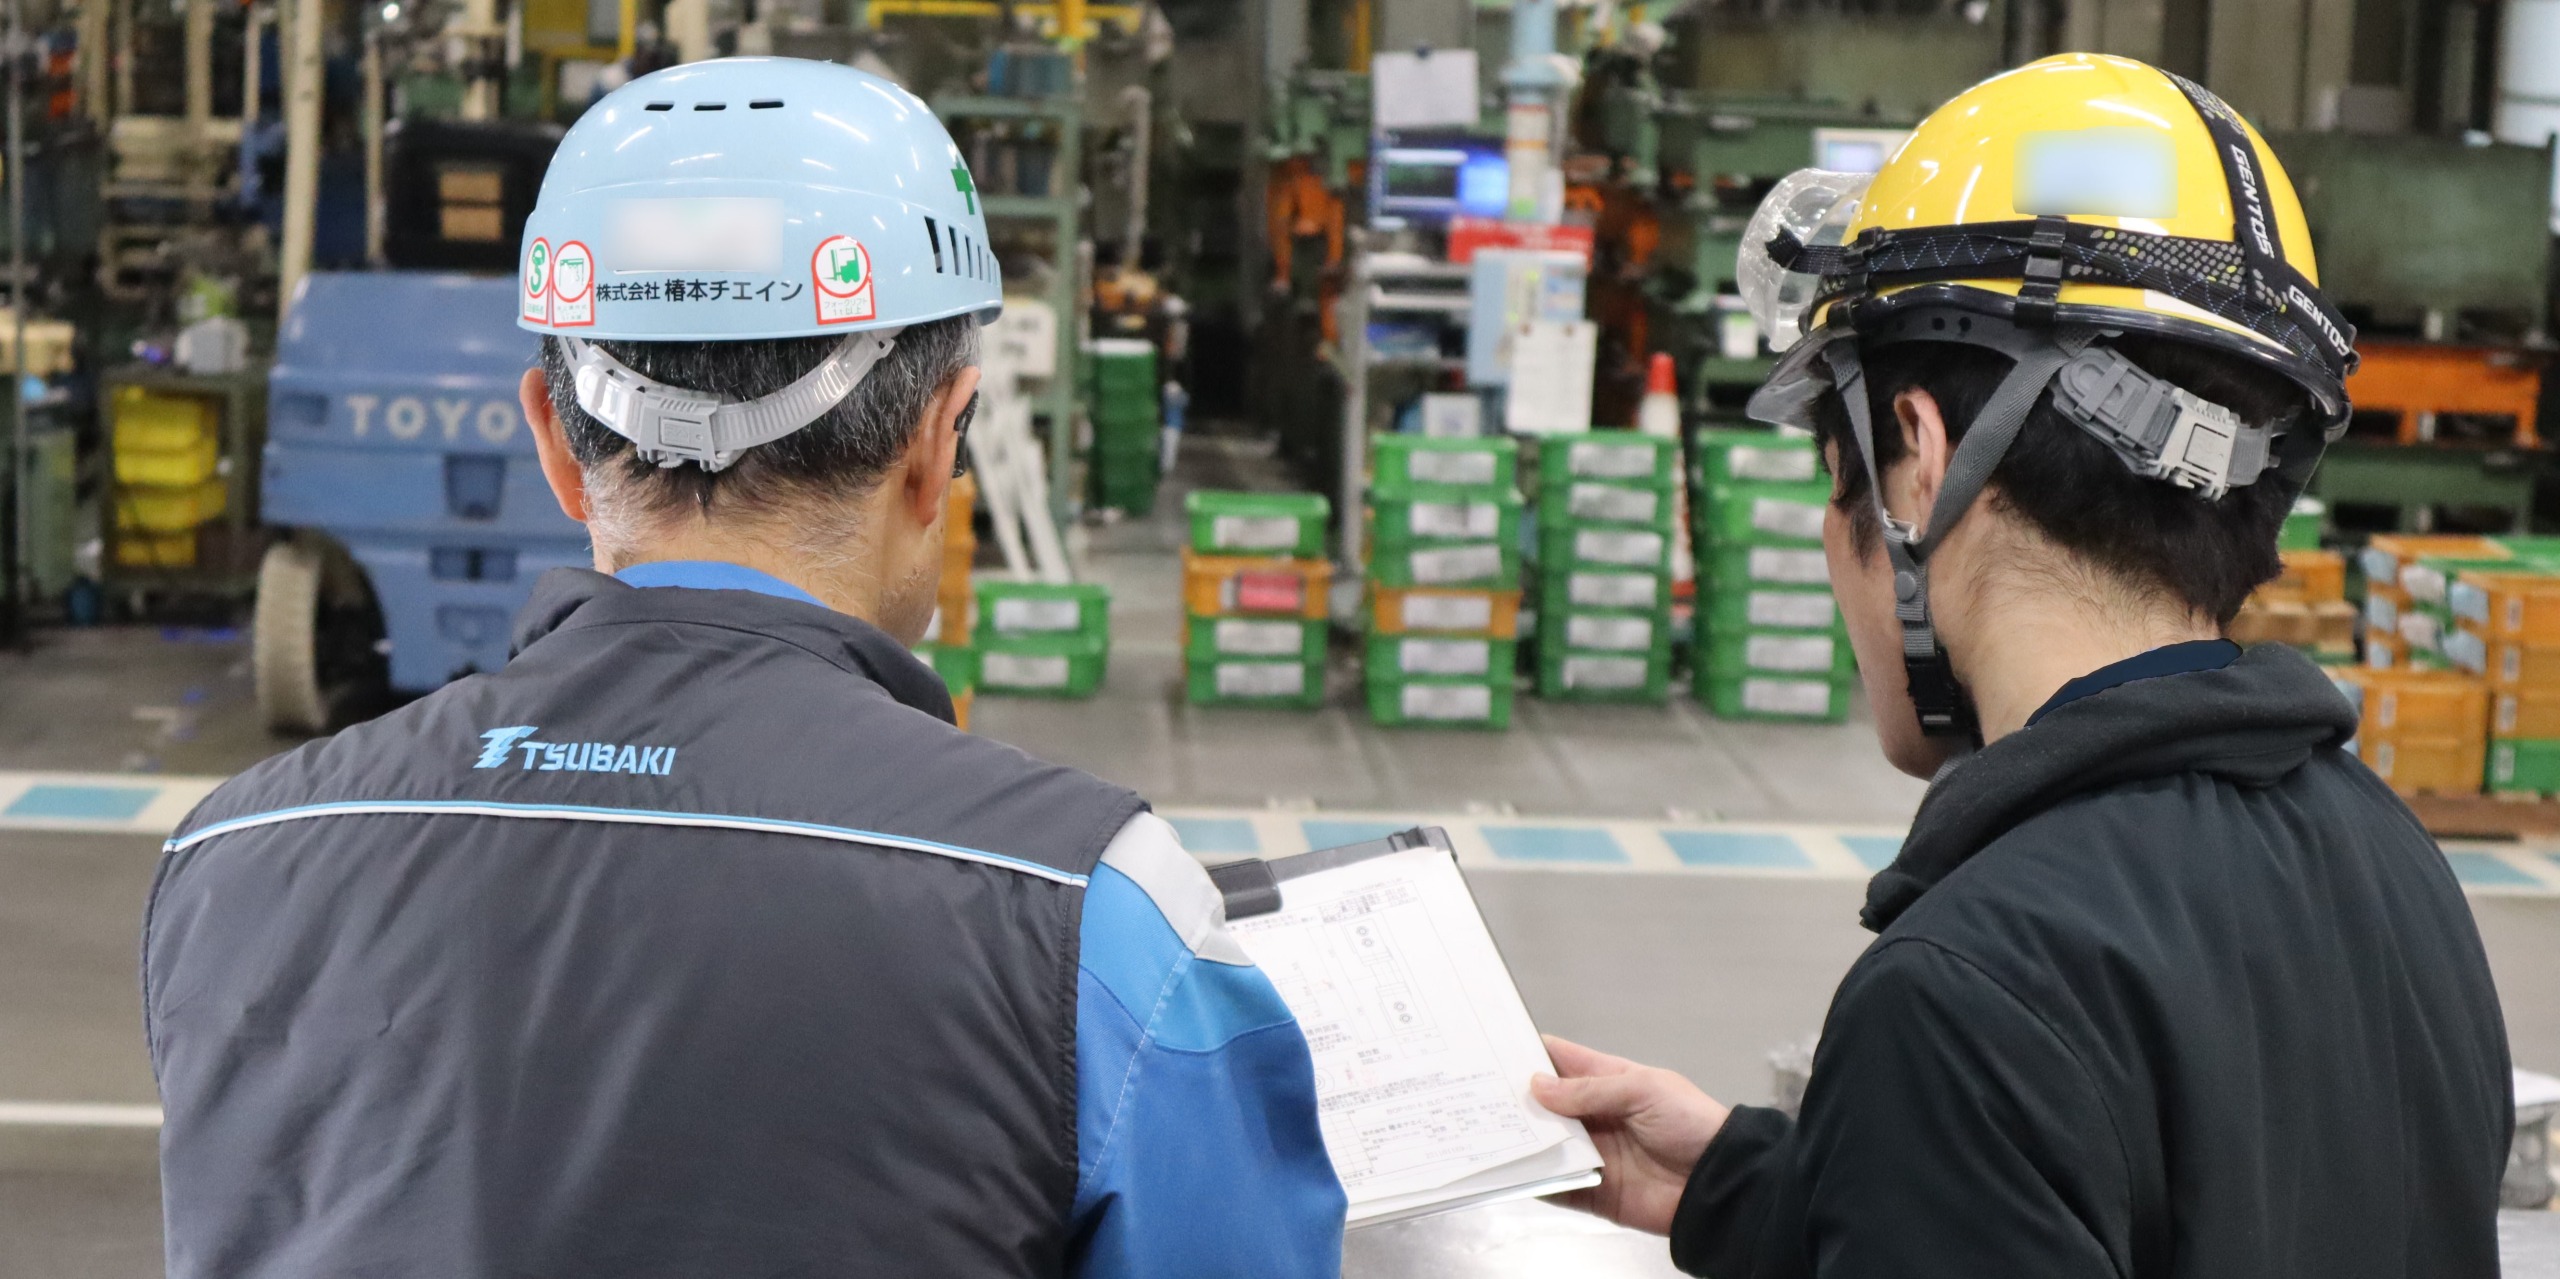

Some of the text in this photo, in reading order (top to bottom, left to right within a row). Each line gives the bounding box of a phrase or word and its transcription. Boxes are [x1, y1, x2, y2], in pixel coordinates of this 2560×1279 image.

[2230, 143, 2275, 259] GENTOS
[596, 279, 804, 302] 株式会社 椿本チエイン
[345, 395, 520, 444] TOYO
[518, 741, 677, 775] TSUBAKI
